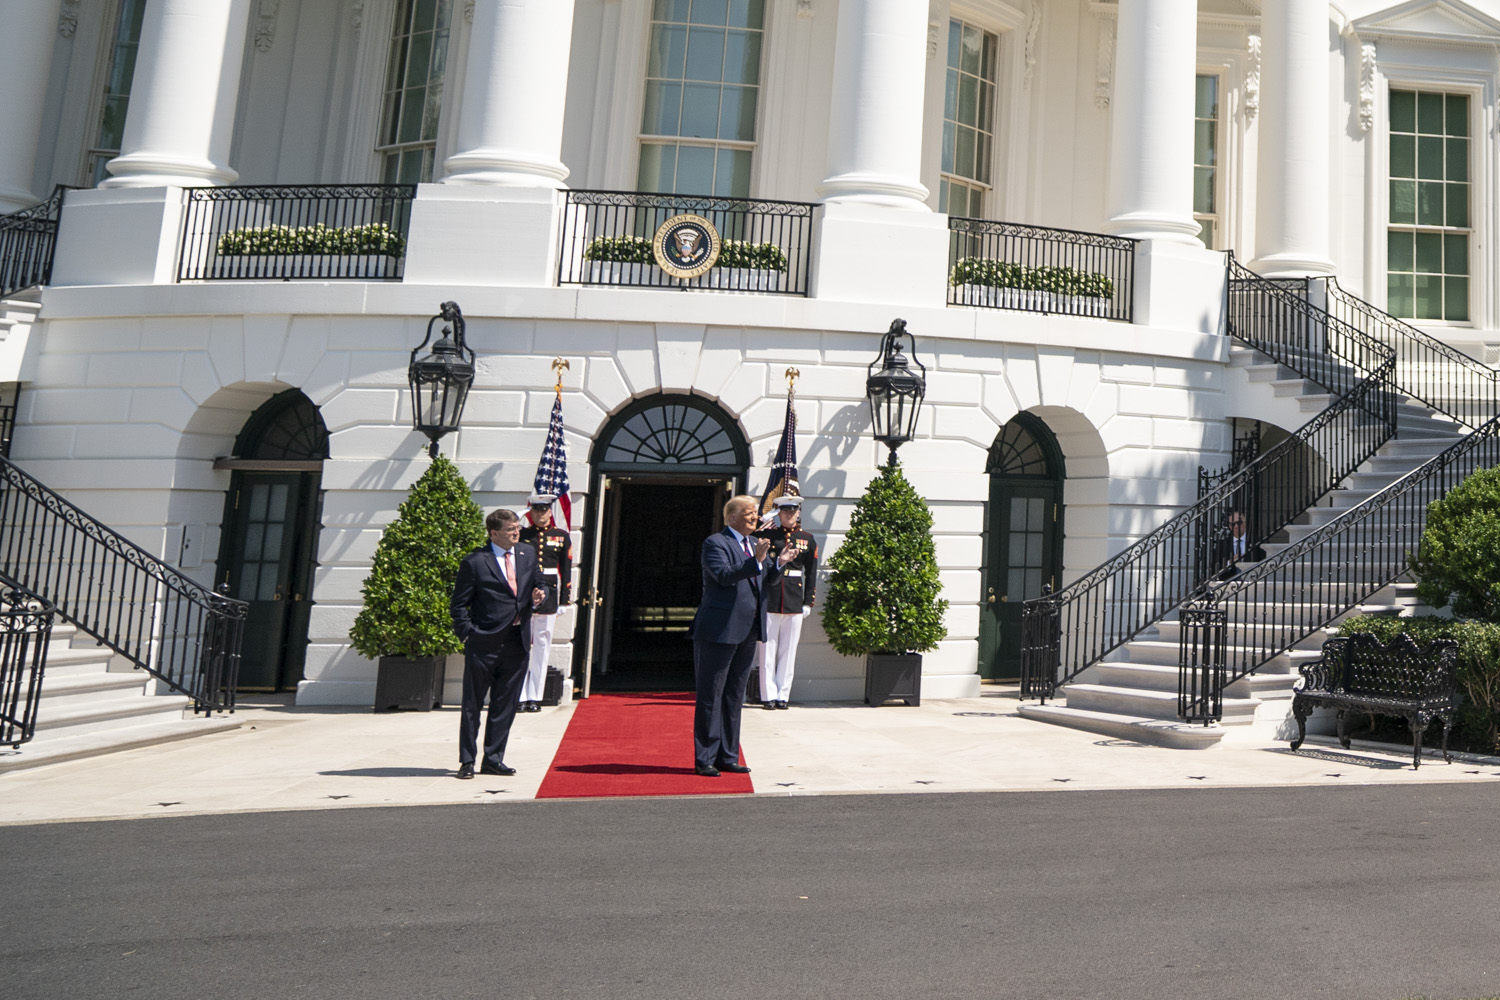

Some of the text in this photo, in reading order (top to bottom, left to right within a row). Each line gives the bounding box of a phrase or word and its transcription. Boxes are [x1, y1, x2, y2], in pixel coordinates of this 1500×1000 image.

[655, 216, 687, 243] PRESIDENT
[706, 224, 719, 253] UNITED
[662, 261, 680, 275] SEAL
[690, 256, 715, 276] STATES
